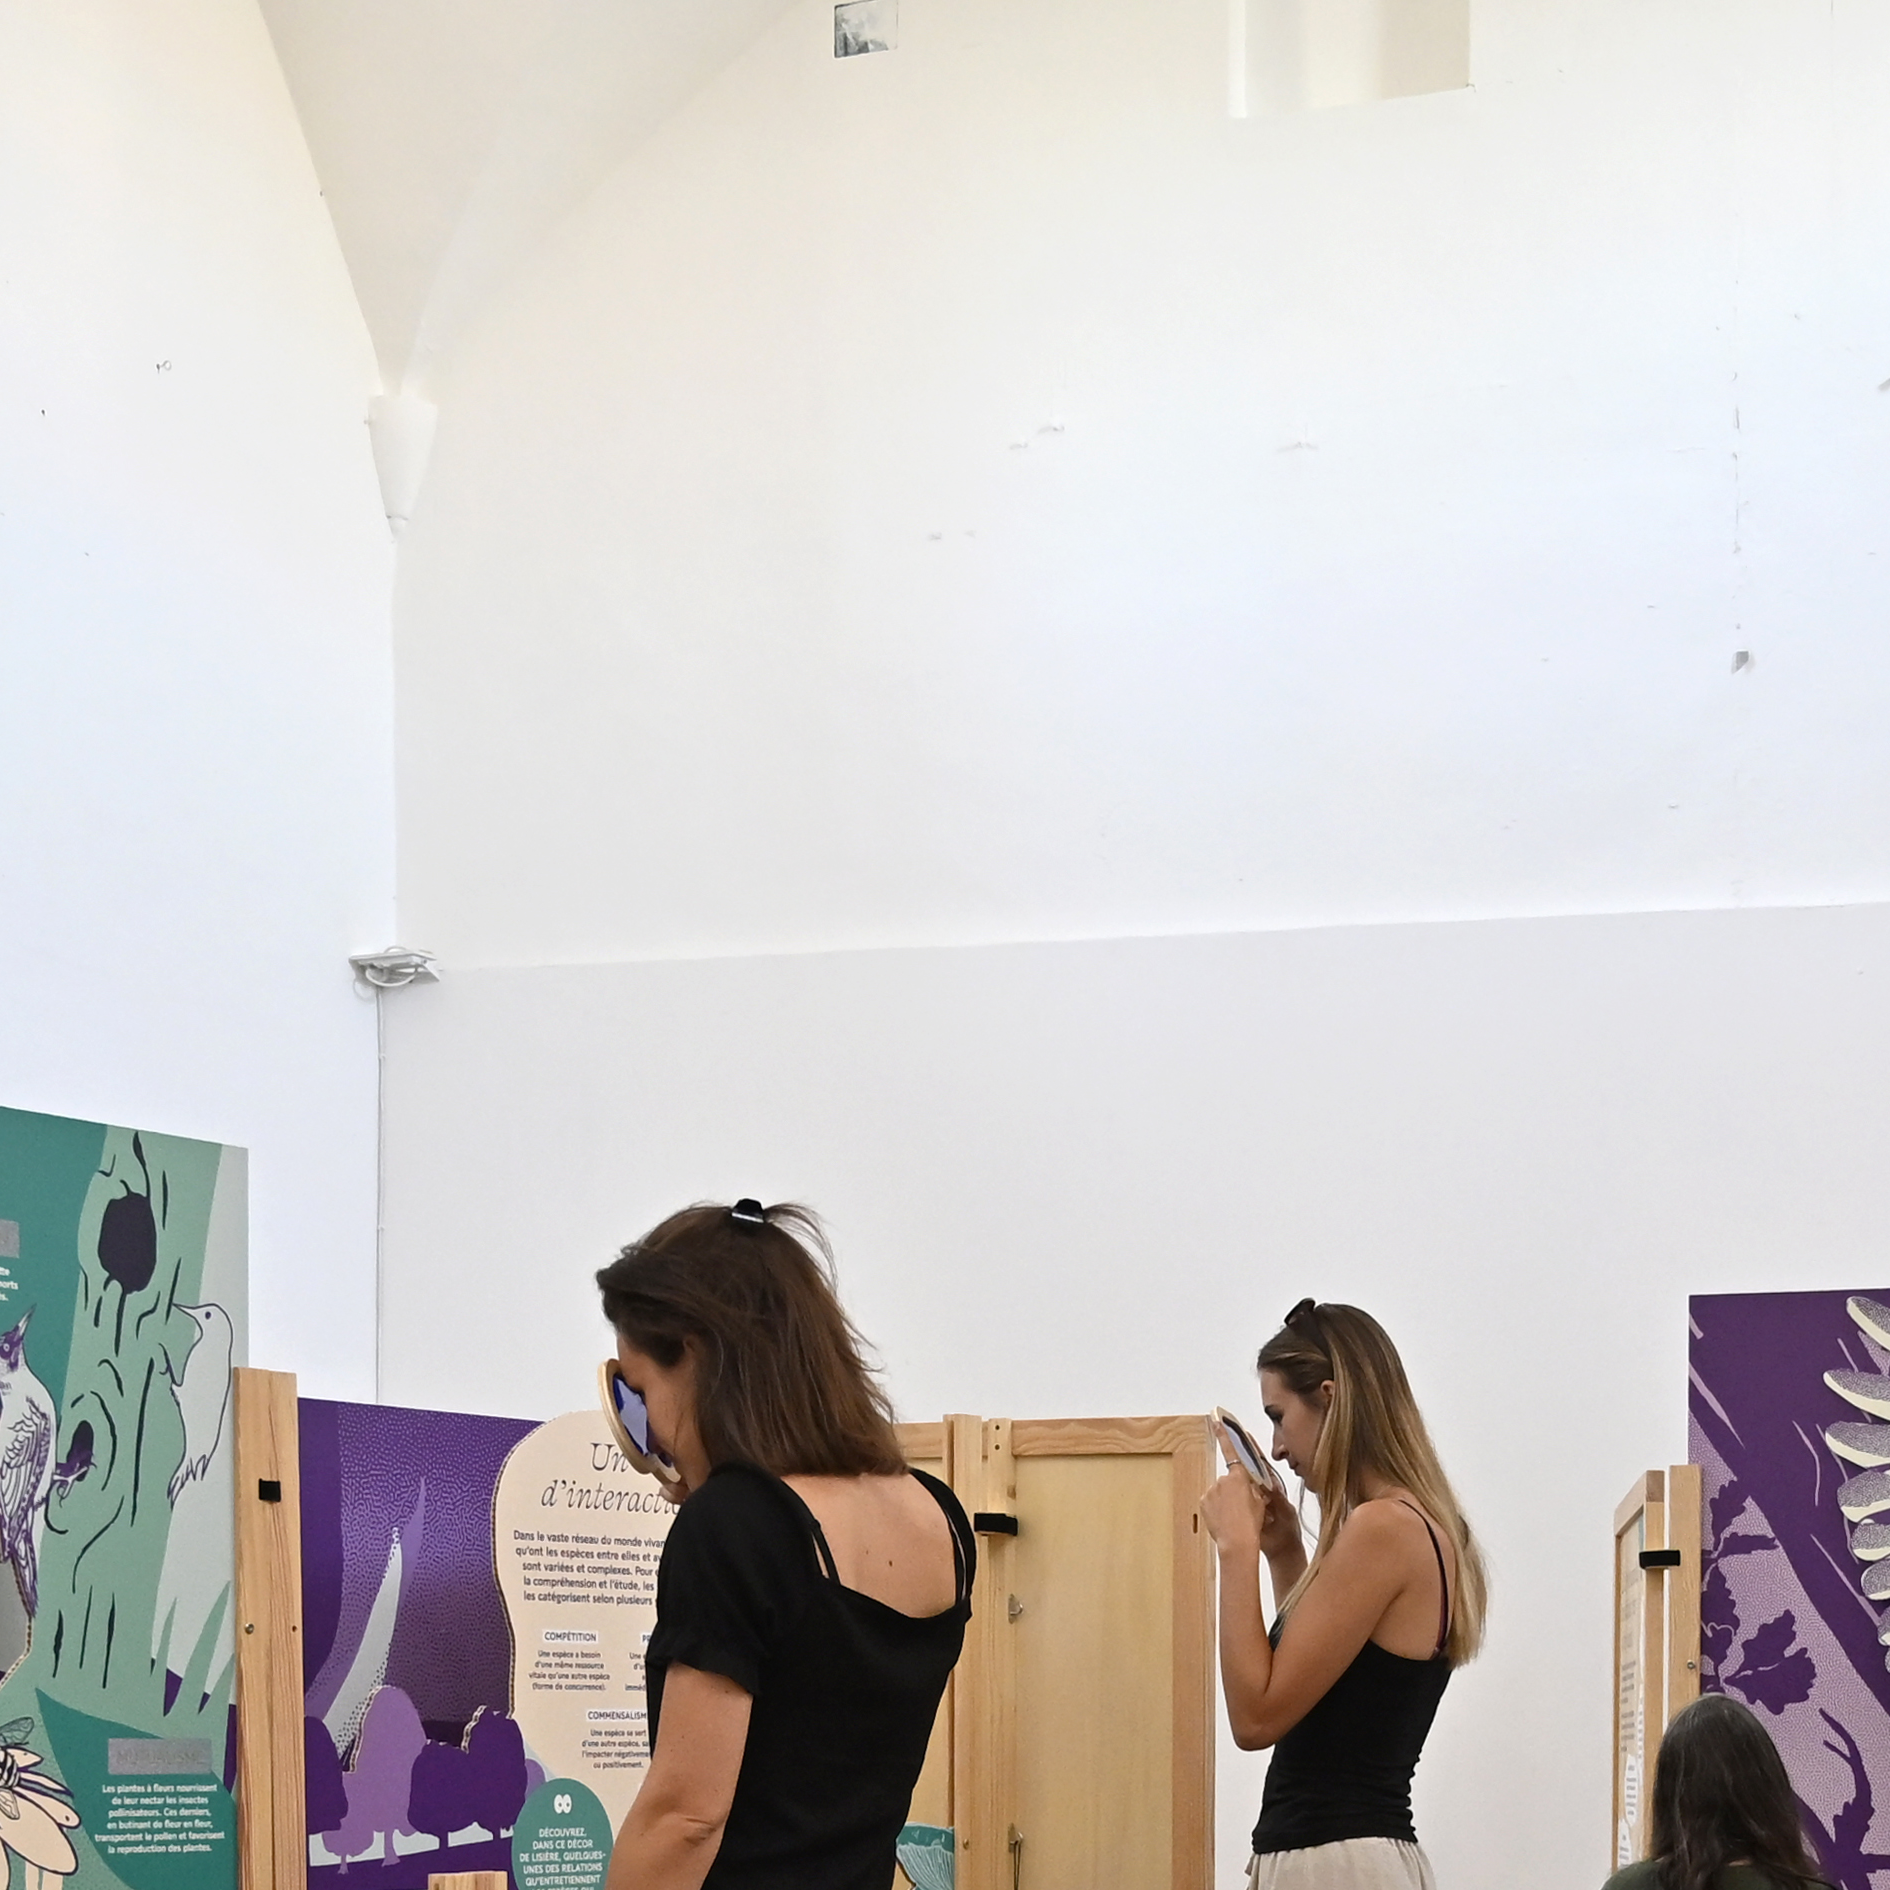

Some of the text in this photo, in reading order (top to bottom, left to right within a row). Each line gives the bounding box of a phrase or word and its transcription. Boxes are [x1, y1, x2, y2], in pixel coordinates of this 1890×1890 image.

[541, 1479, 679, 1516] d'interact
[514, 1530, 666, 1548] Dans le vaste réseau du monde vivan
[515, 1546, 651, 1562] qu'ont les espèces entre elles et
[522, 1562, 653, 1576] sont variées et complexes. Pour
[524, 1590, 653, 1606] les catégorisent selon plusieurs
[588, 1711, 647, 1720] COMMENSALISM
[533, 1839, 593, 1850] DANS CE DÉCOR
[520, 1851, 606, 1862] DE LISIÈRE, QUELQUES-
[523, 1862, 603, 1874] UNES DES RELATIONS
[526, 1874, 601, 1886] QU'ENTRETIENNENT
